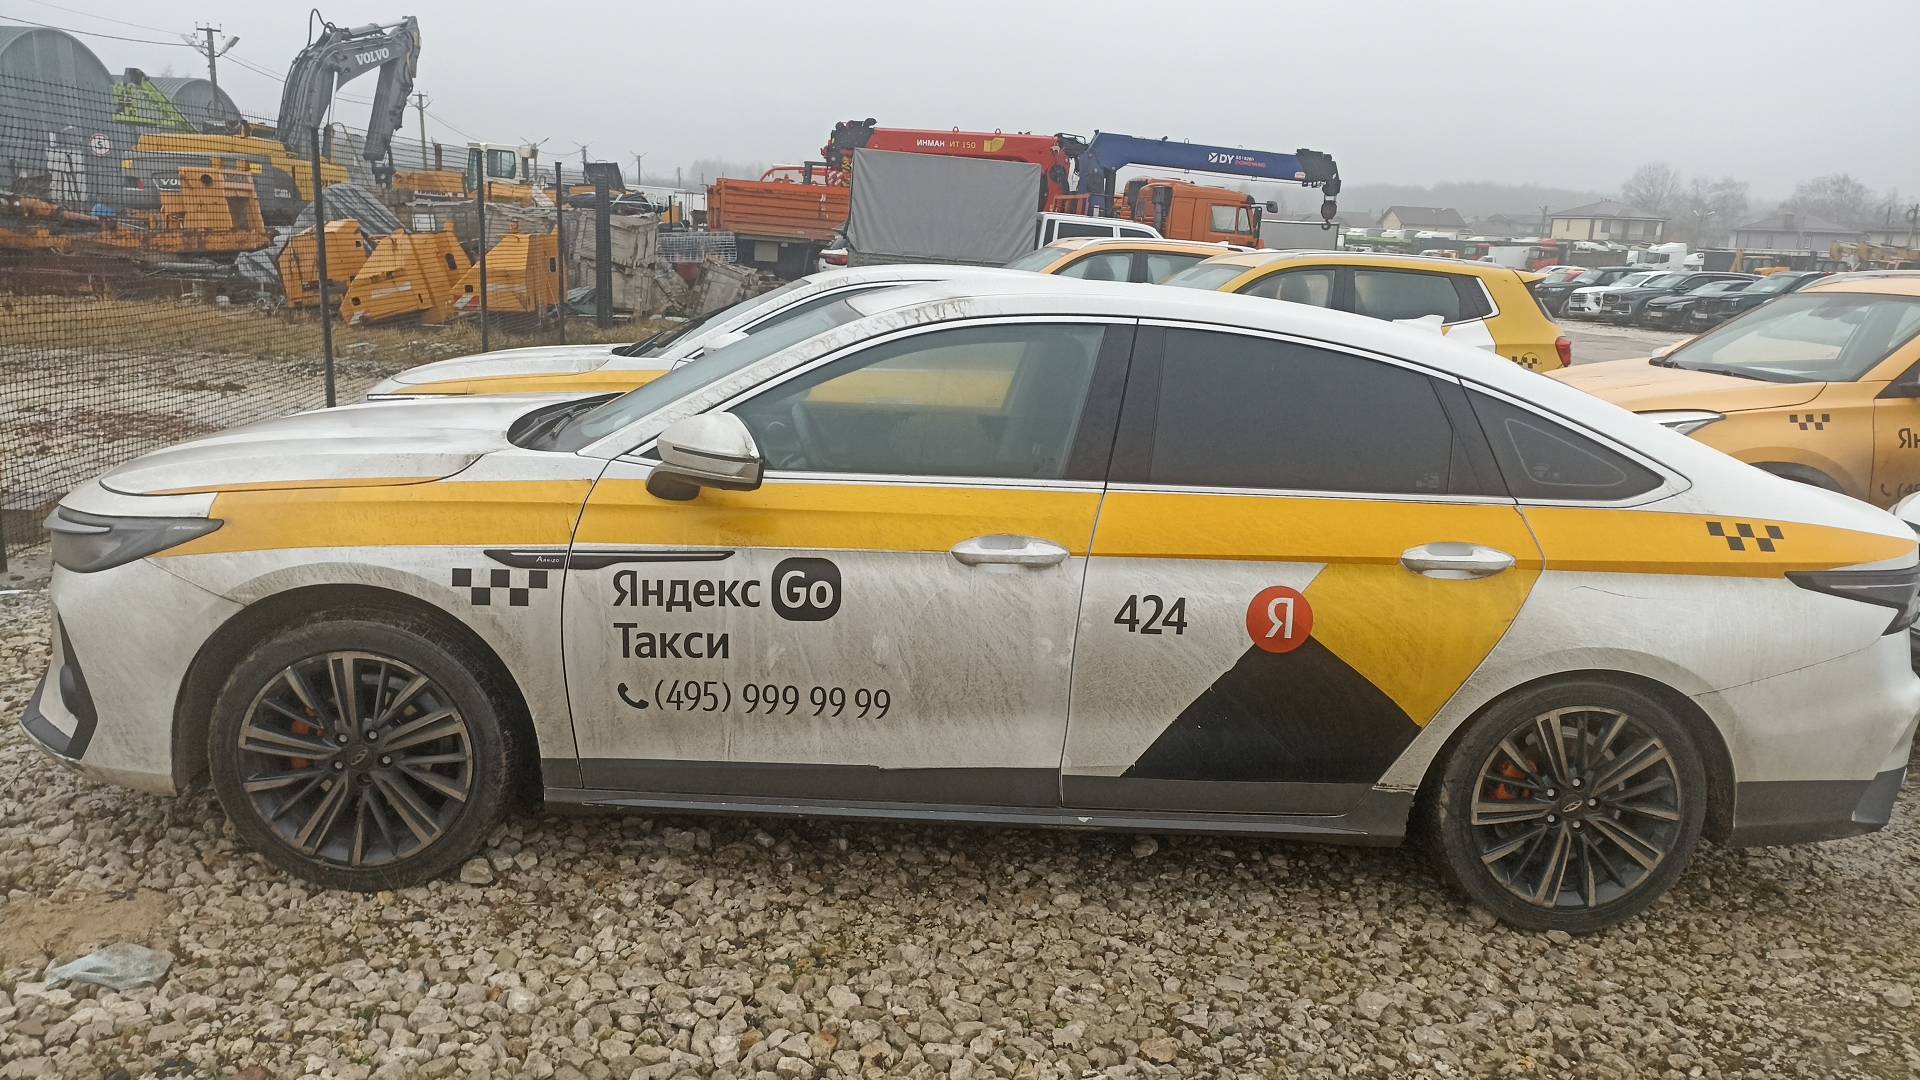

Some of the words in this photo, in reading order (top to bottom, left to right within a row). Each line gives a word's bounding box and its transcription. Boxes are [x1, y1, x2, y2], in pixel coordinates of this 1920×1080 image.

[355, 47, 389, 65] VOLVO
[916, 139, 945, 147] ИНМАН
[962, 141, 976, 149] 150
[1219, 154, 1234, 164] DY
[613, 569, 761, 612] Яндекс
[779, 570, 834, 609] Go
[1114, 595, 1188, 635] 424
[1265, 597, 1294, 639] Я
[613, 622, 730, 659] Такси
[654, 679, 732, 712] (495)
[742, 683, 800, 715] 999
[809, 686, 847, 717] 99
[854, 688, 892, 719] 99
